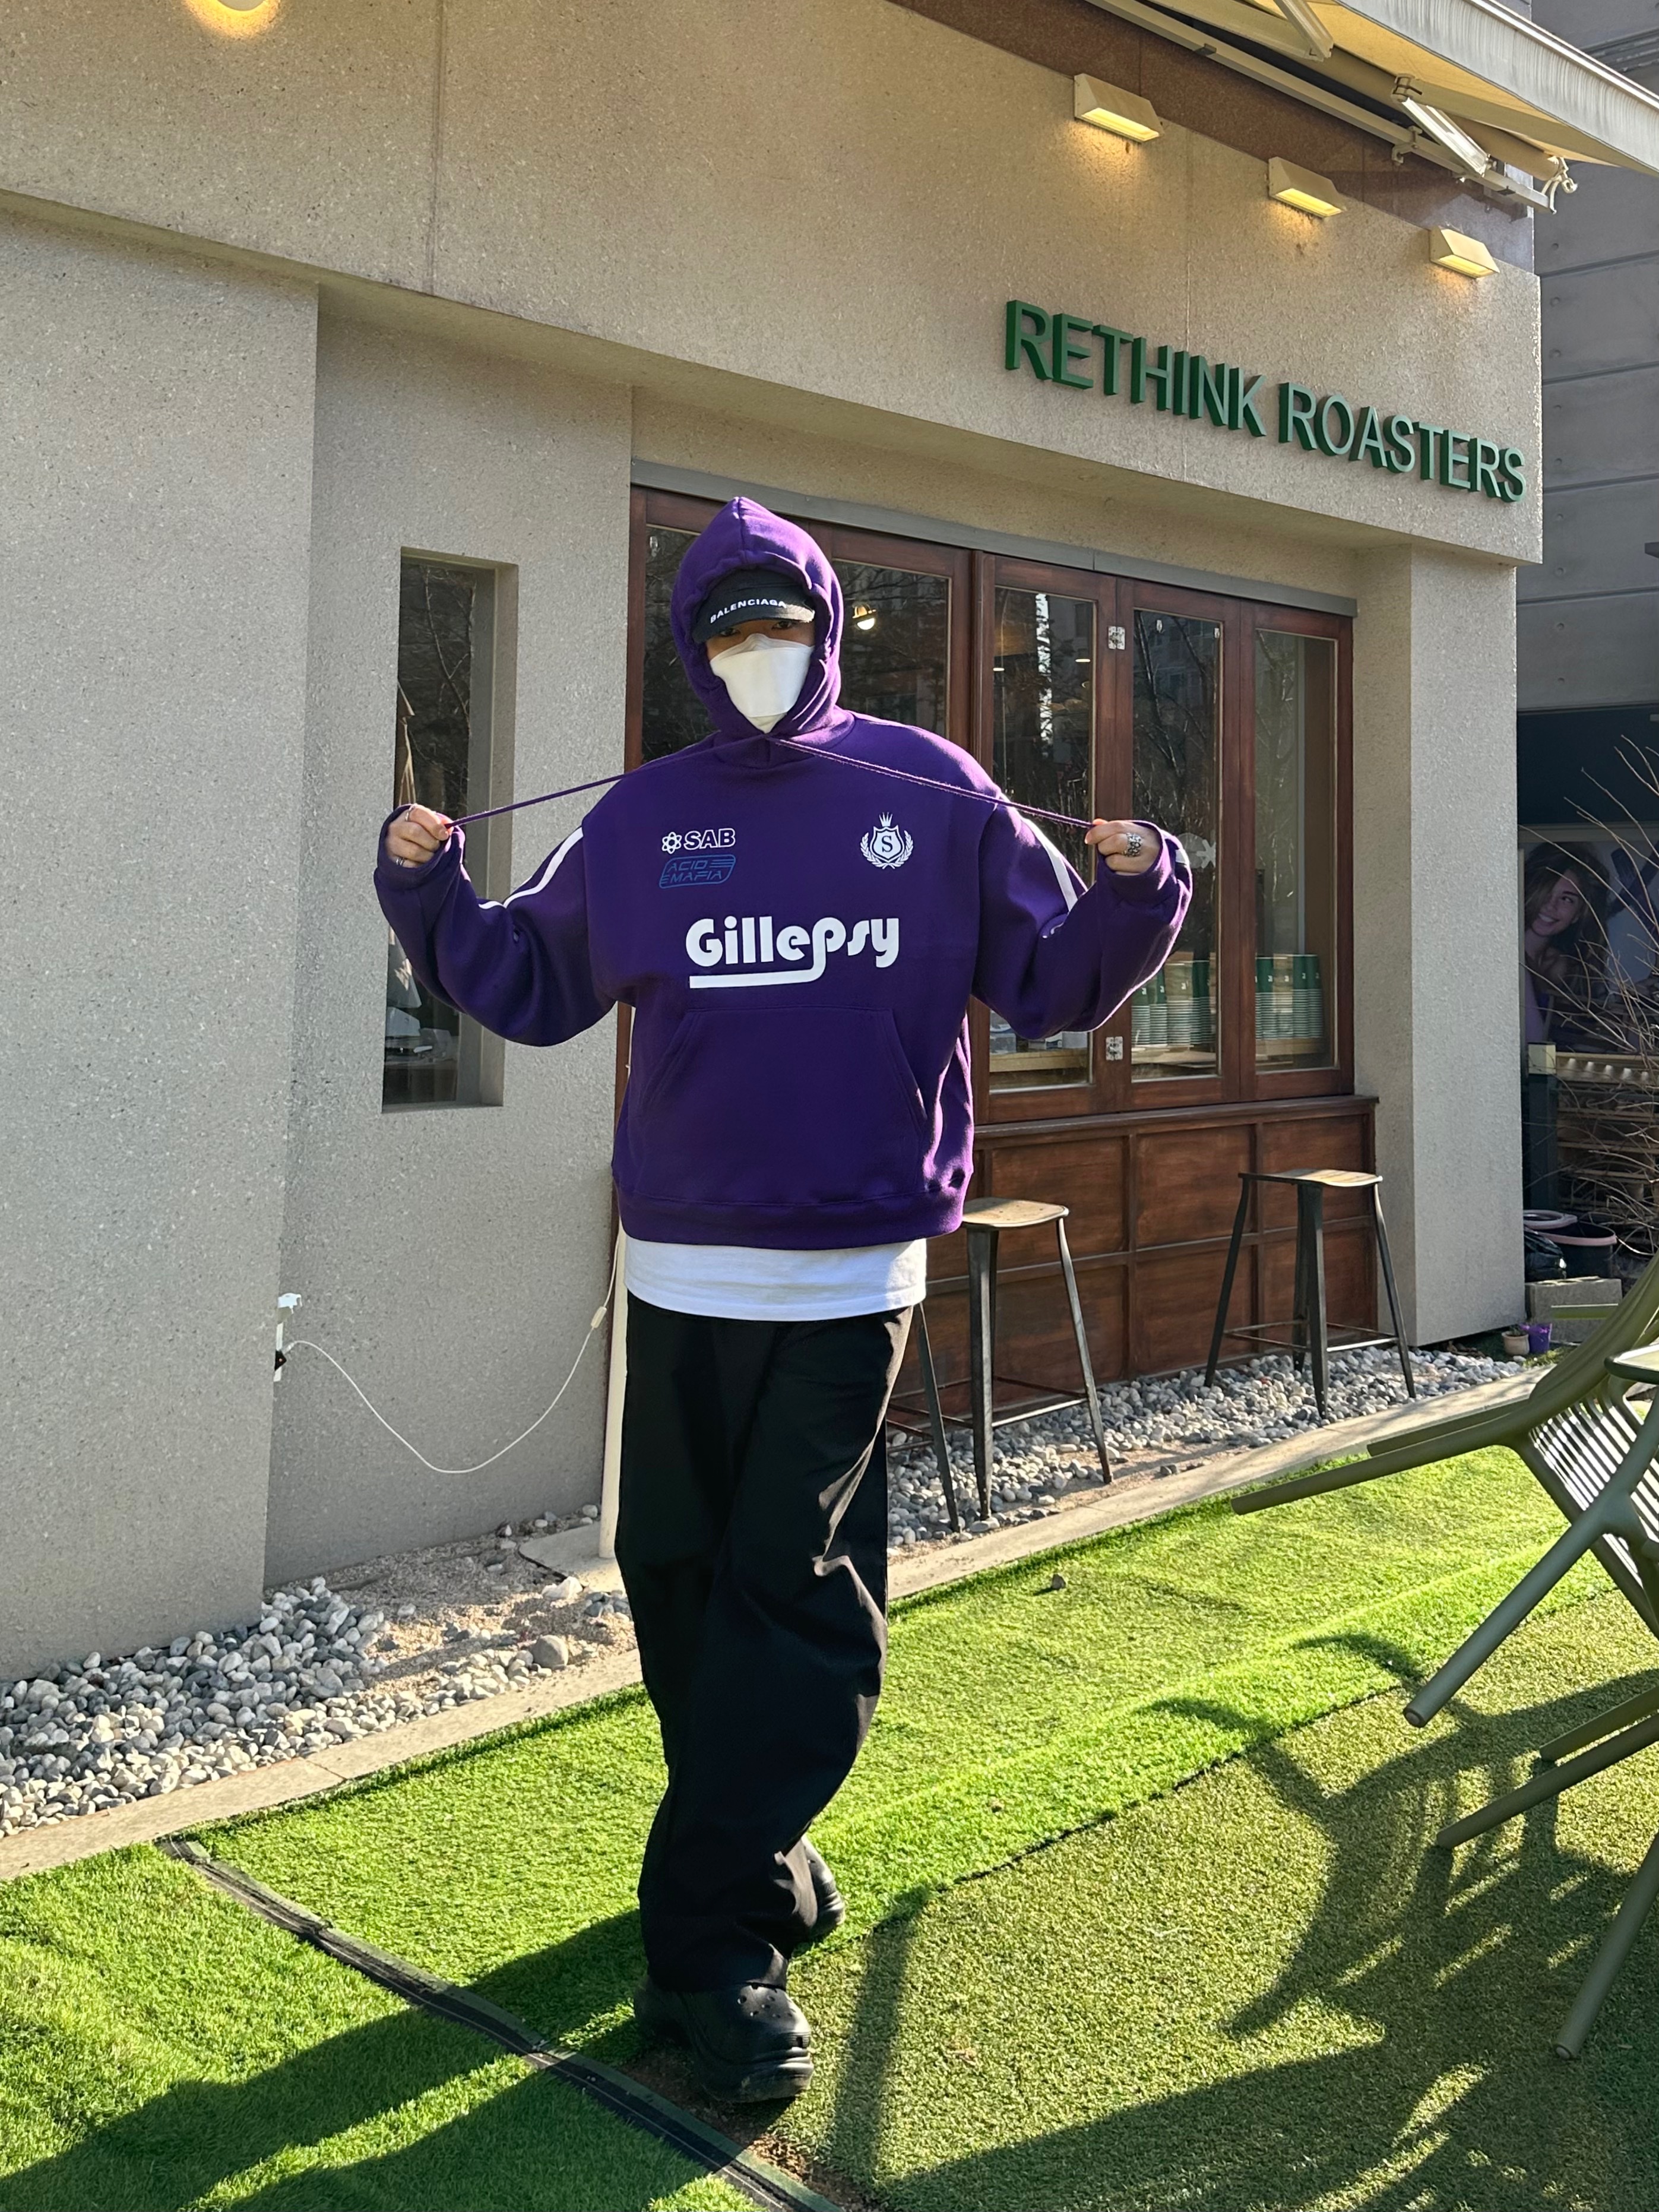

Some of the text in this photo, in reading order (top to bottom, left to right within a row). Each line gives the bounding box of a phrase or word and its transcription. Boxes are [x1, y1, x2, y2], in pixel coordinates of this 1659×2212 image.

[1005, 300, 1525, 502] RETHINK ROASTERS
[710, 599, 787, 624] BALENCIAGA
[683, 828, 736, 850] SAB
[881, 835, 893, 853] S
[667, 860, 708, 873] ACID
[670, 870, 722, 884] MAFIA
[685, 916, 899, 989] Gillepsy
